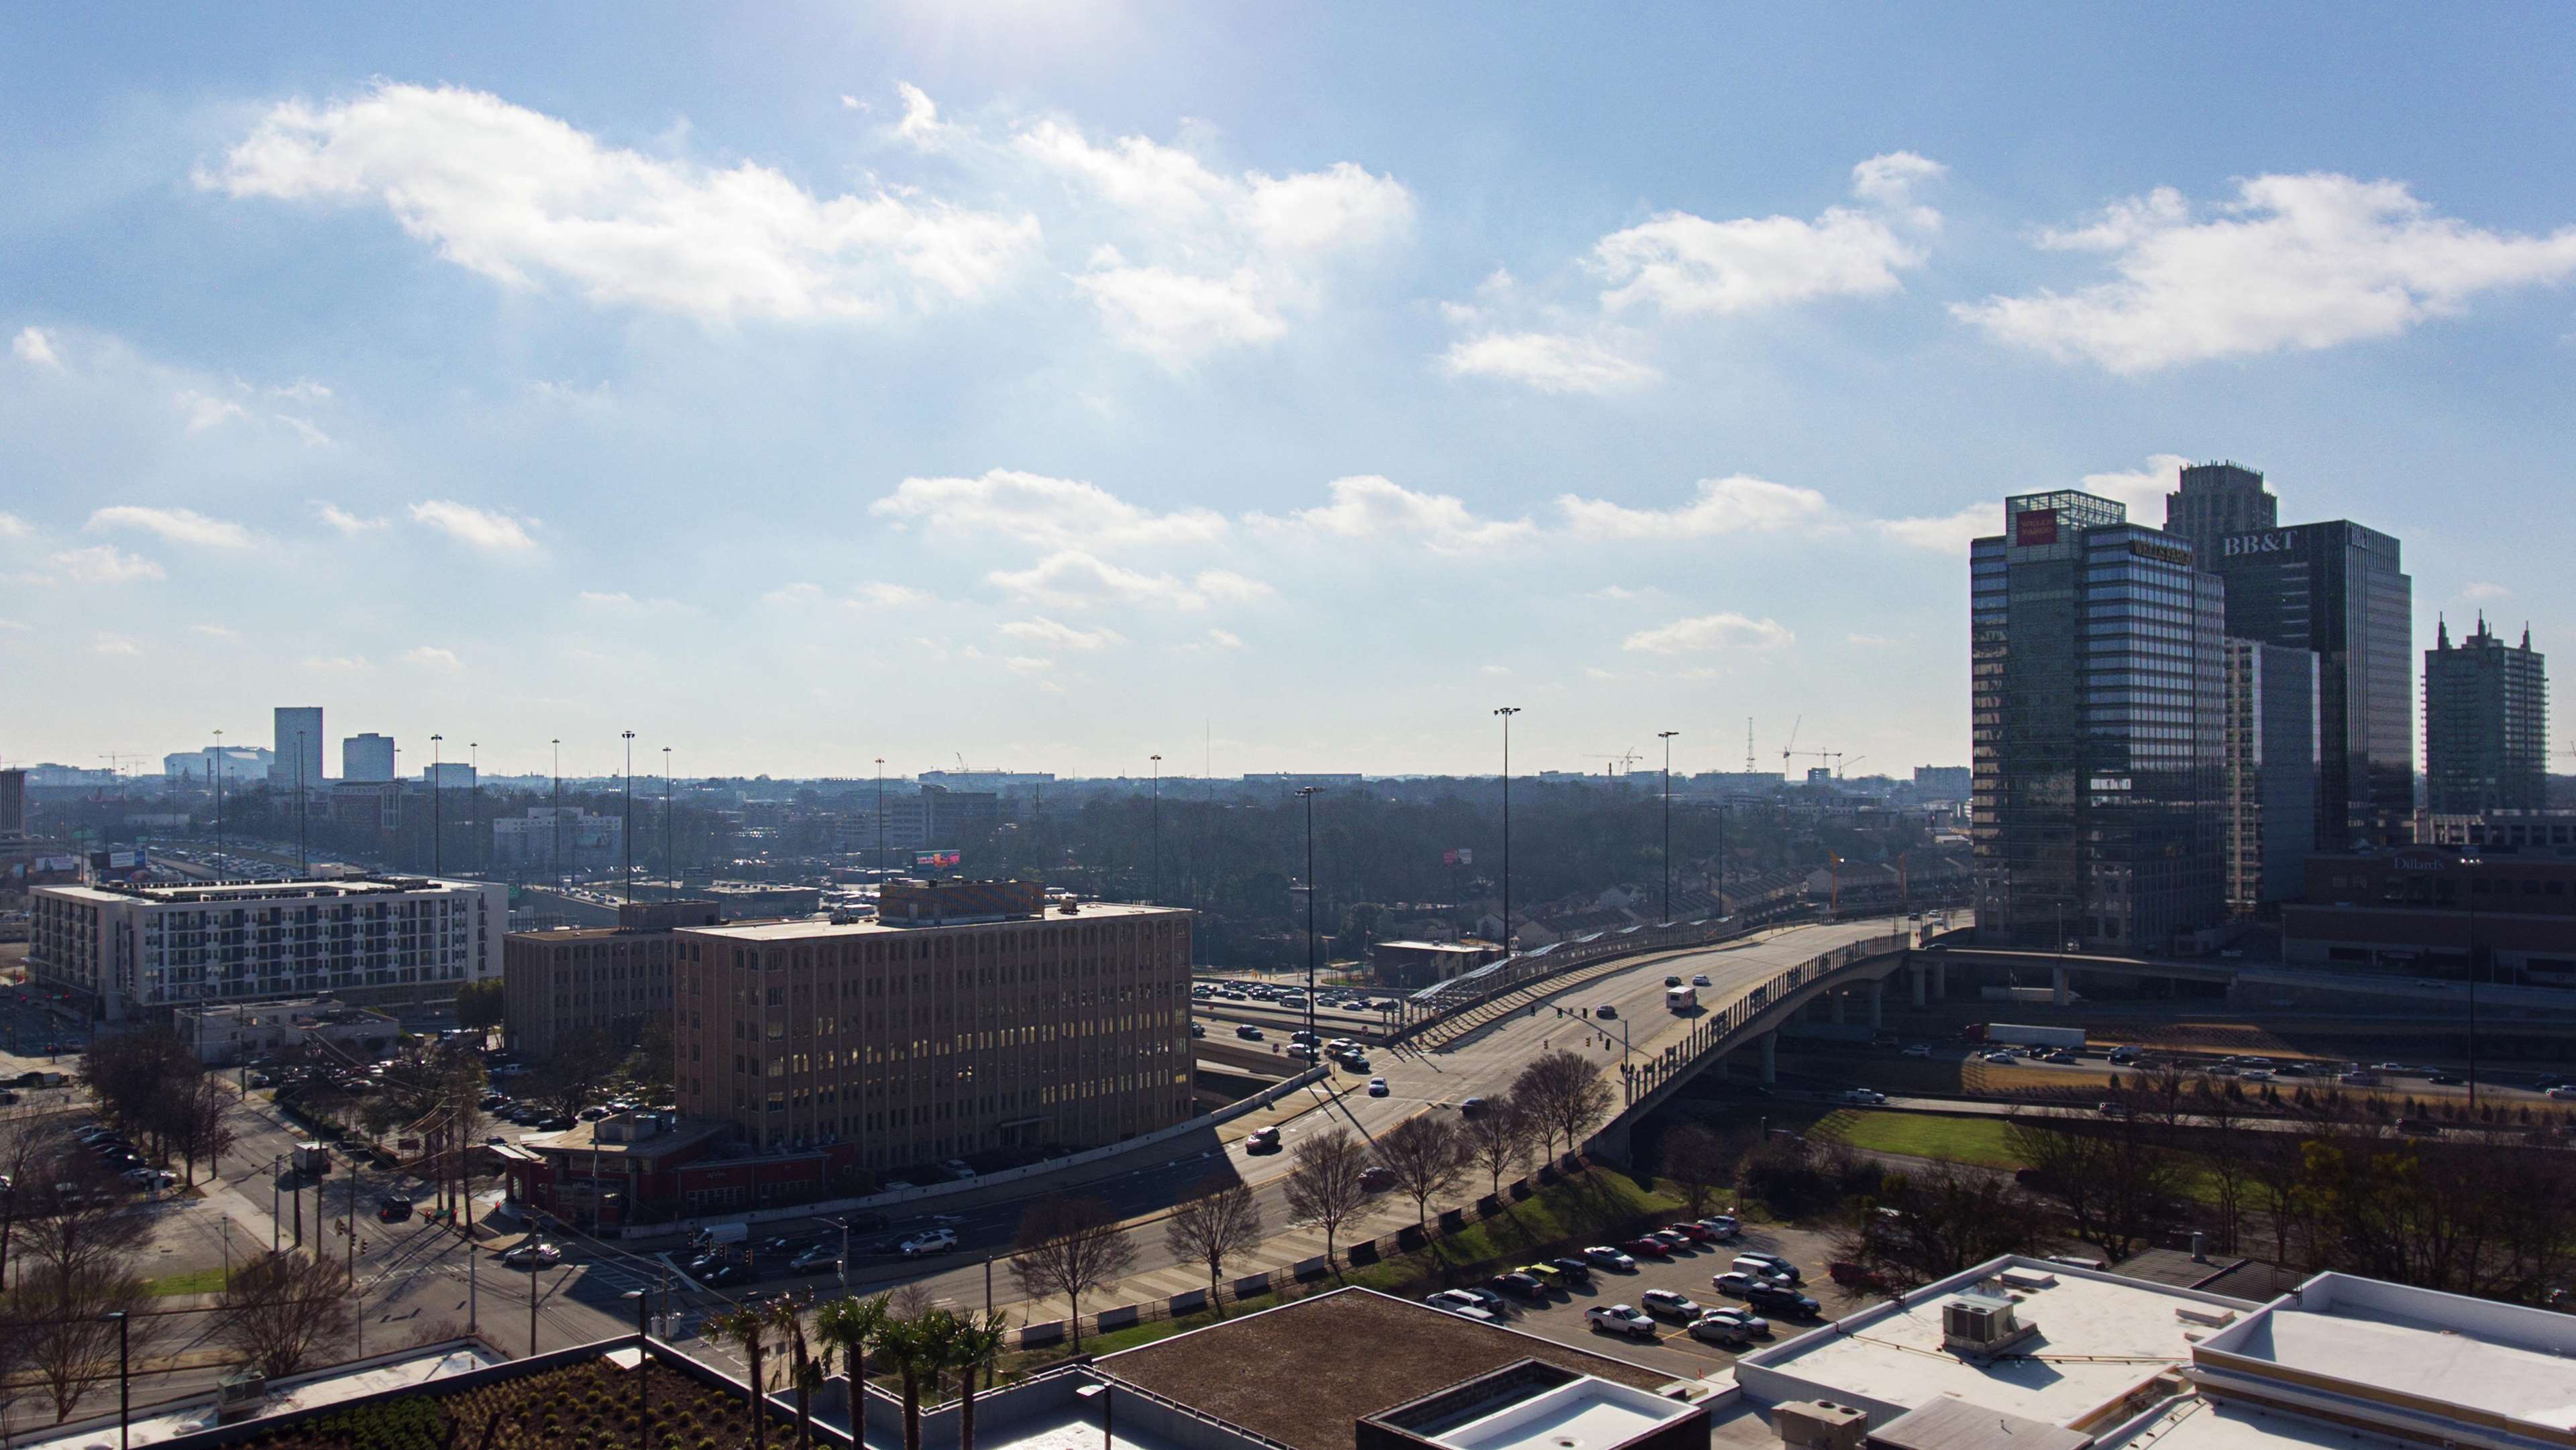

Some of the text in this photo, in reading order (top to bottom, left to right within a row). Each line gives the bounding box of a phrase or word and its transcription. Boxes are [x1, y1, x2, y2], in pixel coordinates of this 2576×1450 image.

[2135, 540, 2166, 561] WELLS
[2223, 531, 2298, 555] BB&T
[2394, 858, 2446, 870] Dillard's
